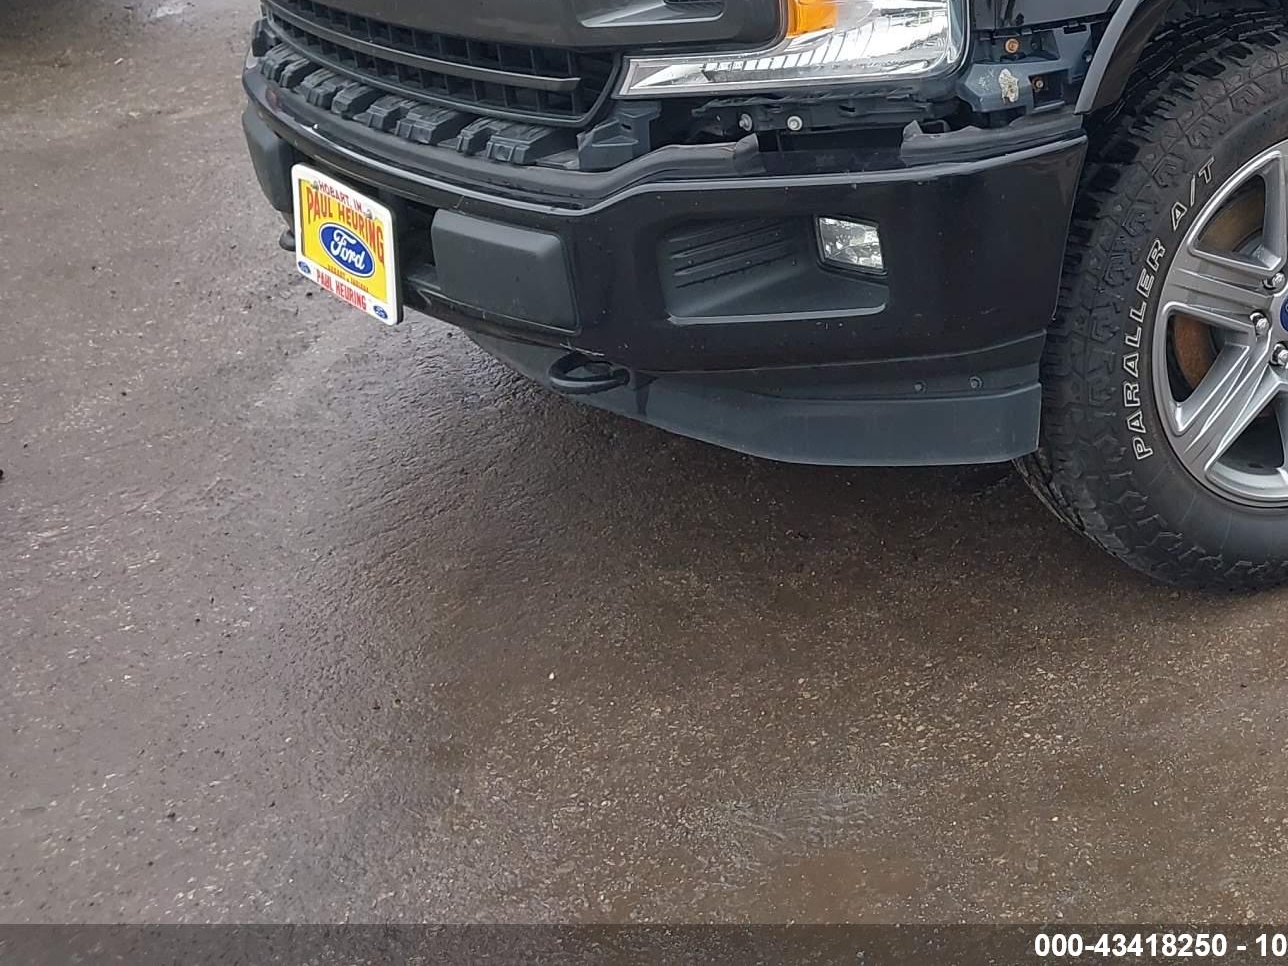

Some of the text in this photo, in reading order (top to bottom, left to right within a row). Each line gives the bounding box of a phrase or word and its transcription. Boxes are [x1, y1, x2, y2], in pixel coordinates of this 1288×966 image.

[306, 186, 385, 264] PAUL HEURING
[330, 229, 366, 270] Ford
[316, 269, 367, 311] PAUL HEURING
[1123, 155, 1216, 461] PARALLER A/T
